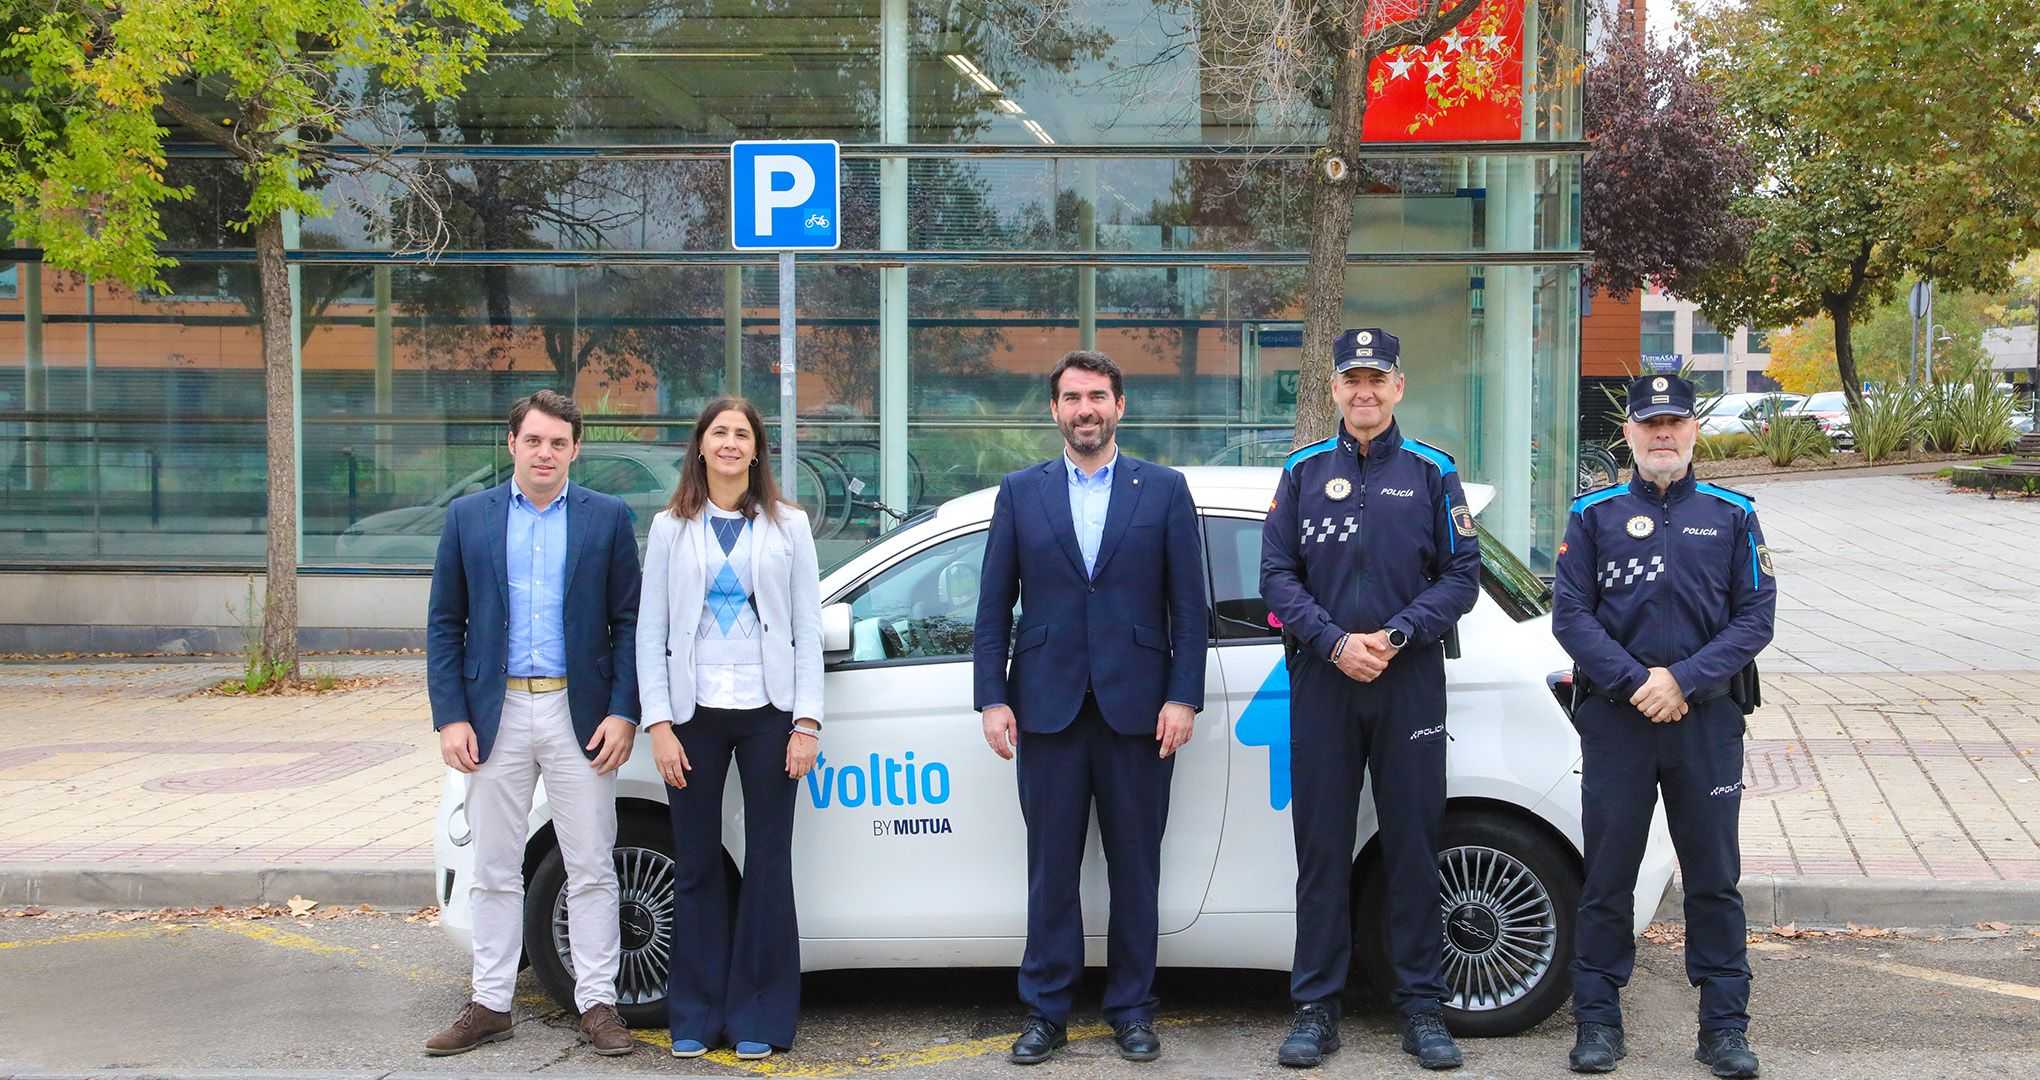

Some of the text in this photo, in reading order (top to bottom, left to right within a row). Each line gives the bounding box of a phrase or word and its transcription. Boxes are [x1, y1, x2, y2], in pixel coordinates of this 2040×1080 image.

[754, 155, 816, 236] P
[1380, 488, 1415, 497] POLICÍA
[1682, 527, 1718, 536] POLICÍA
[873, 818, 952, 836] BY MUTUA
